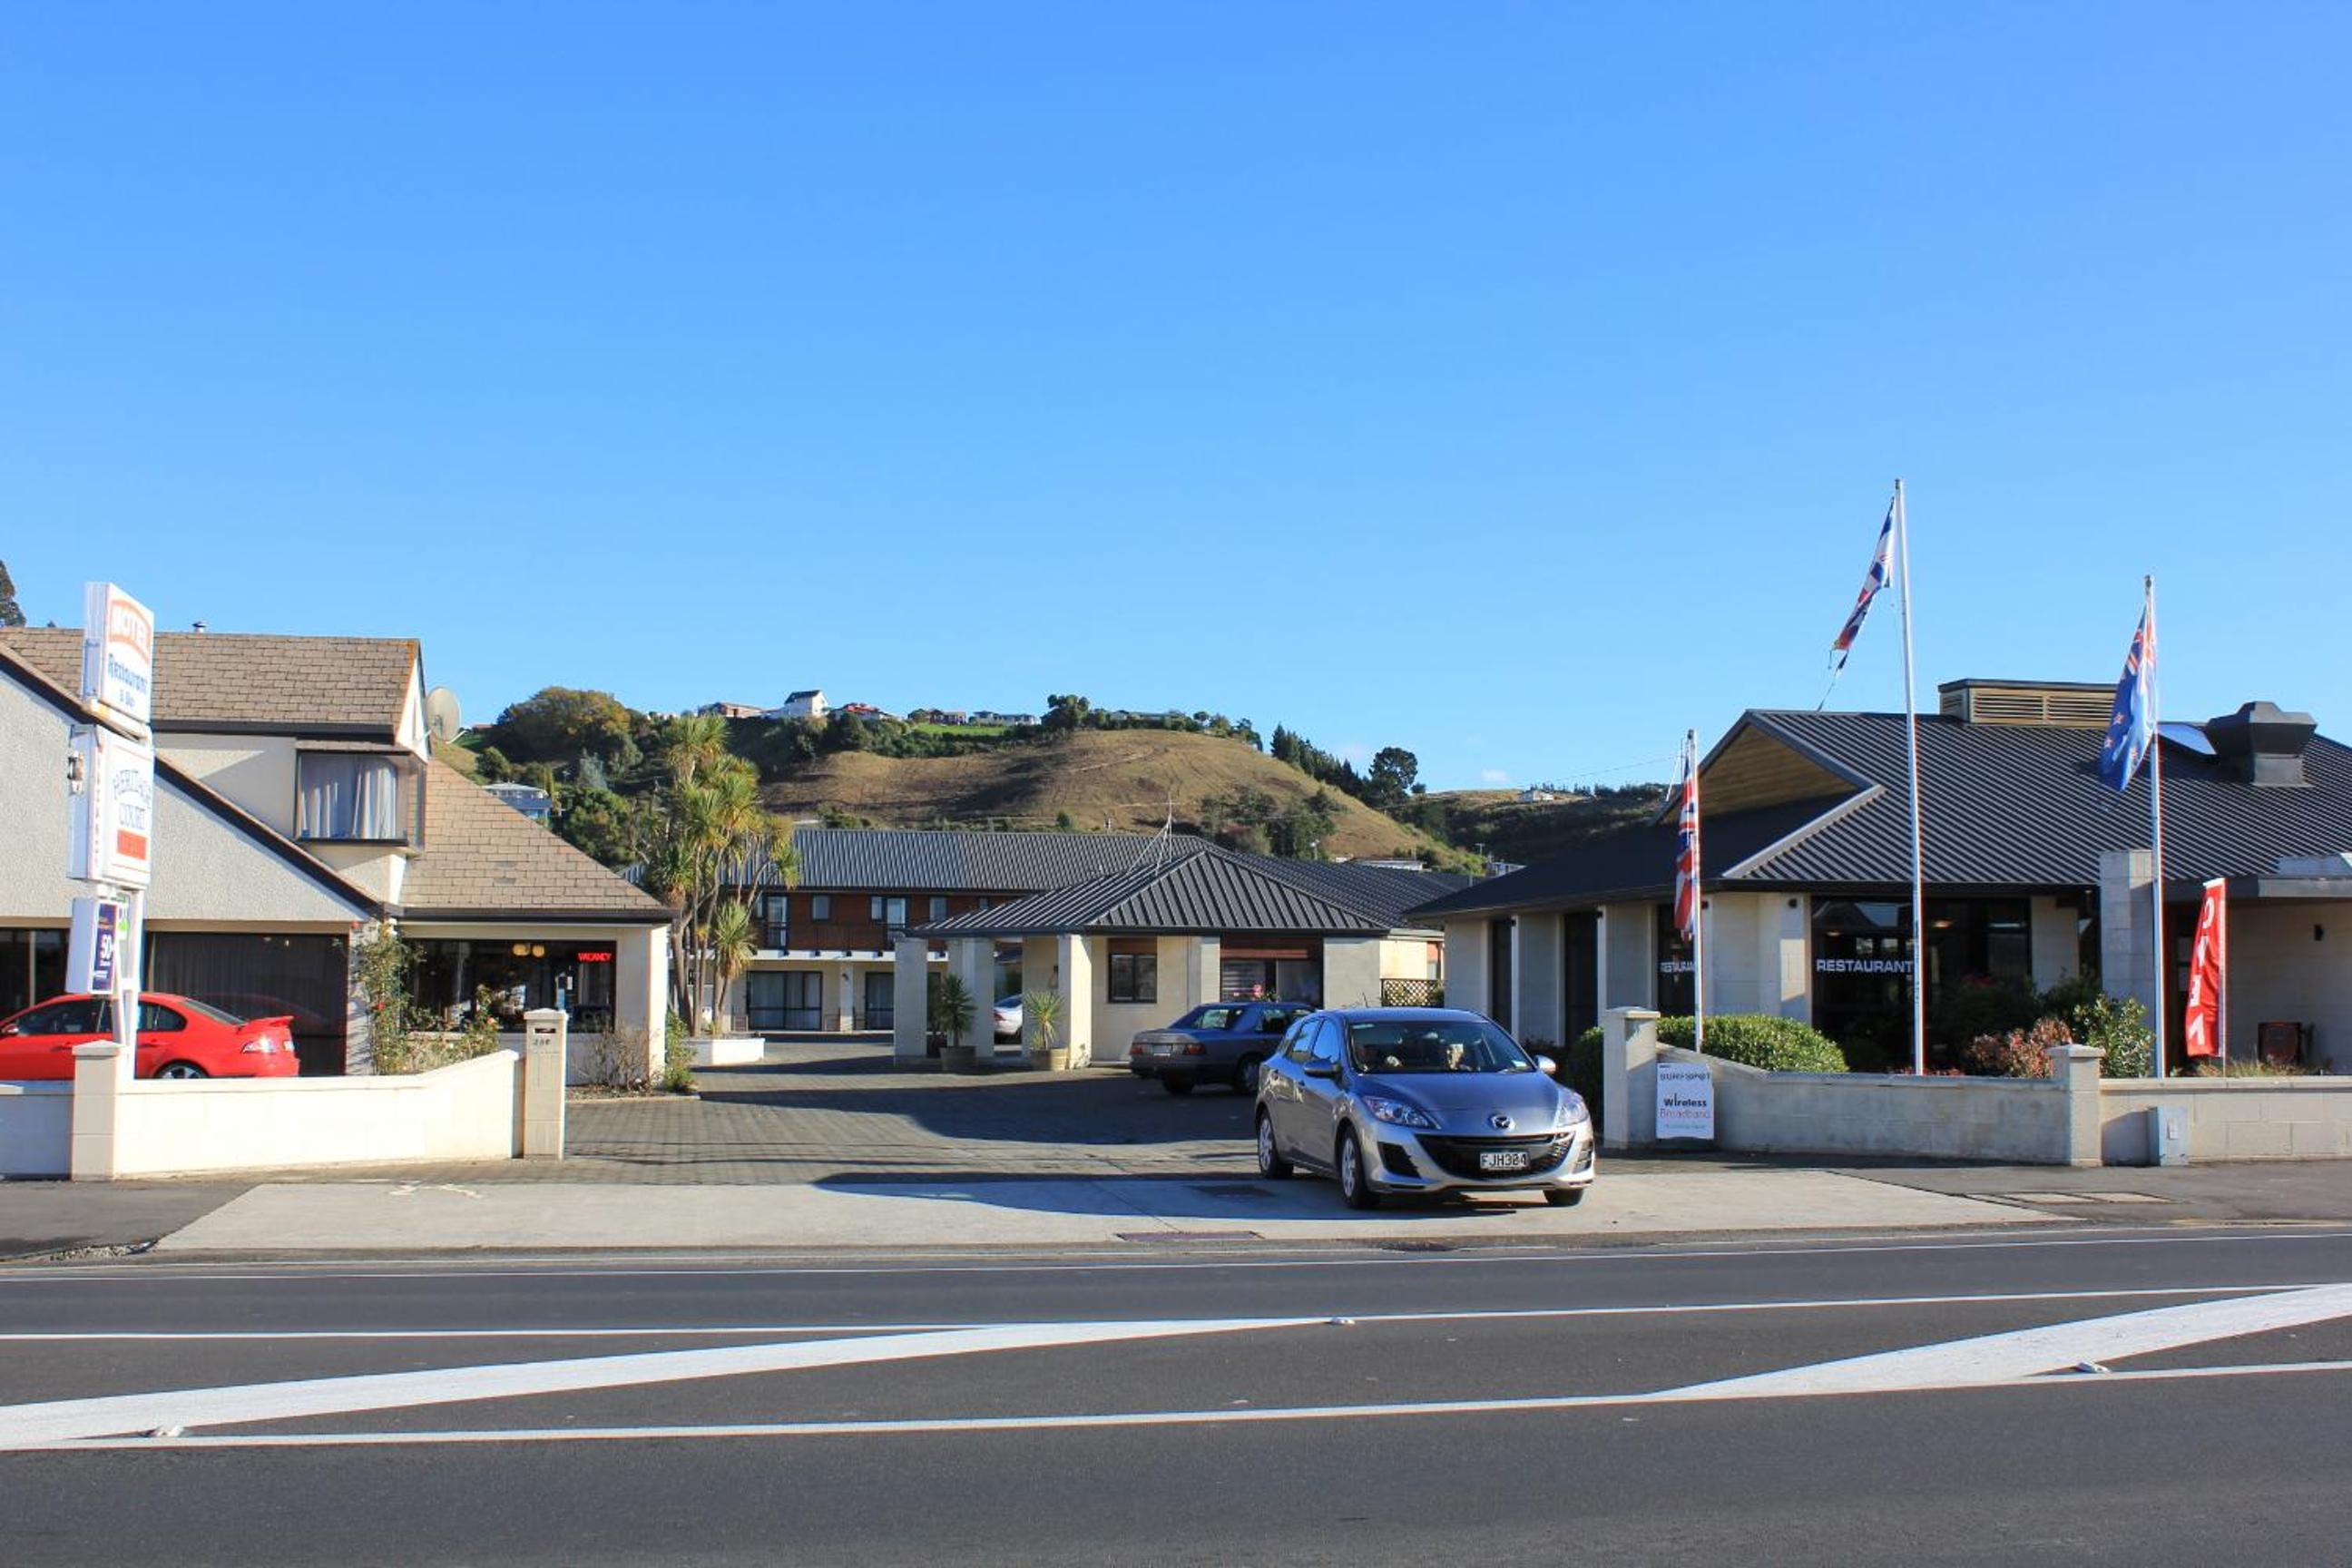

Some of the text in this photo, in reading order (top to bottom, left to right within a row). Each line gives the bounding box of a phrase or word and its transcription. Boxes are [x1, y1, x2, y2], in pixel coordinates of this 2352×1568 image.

[118, 802, 147, 830] COURT
[577, 952, 612, 962] VACANCY
[1816, 959, 1913, 974] RESTAURANT
